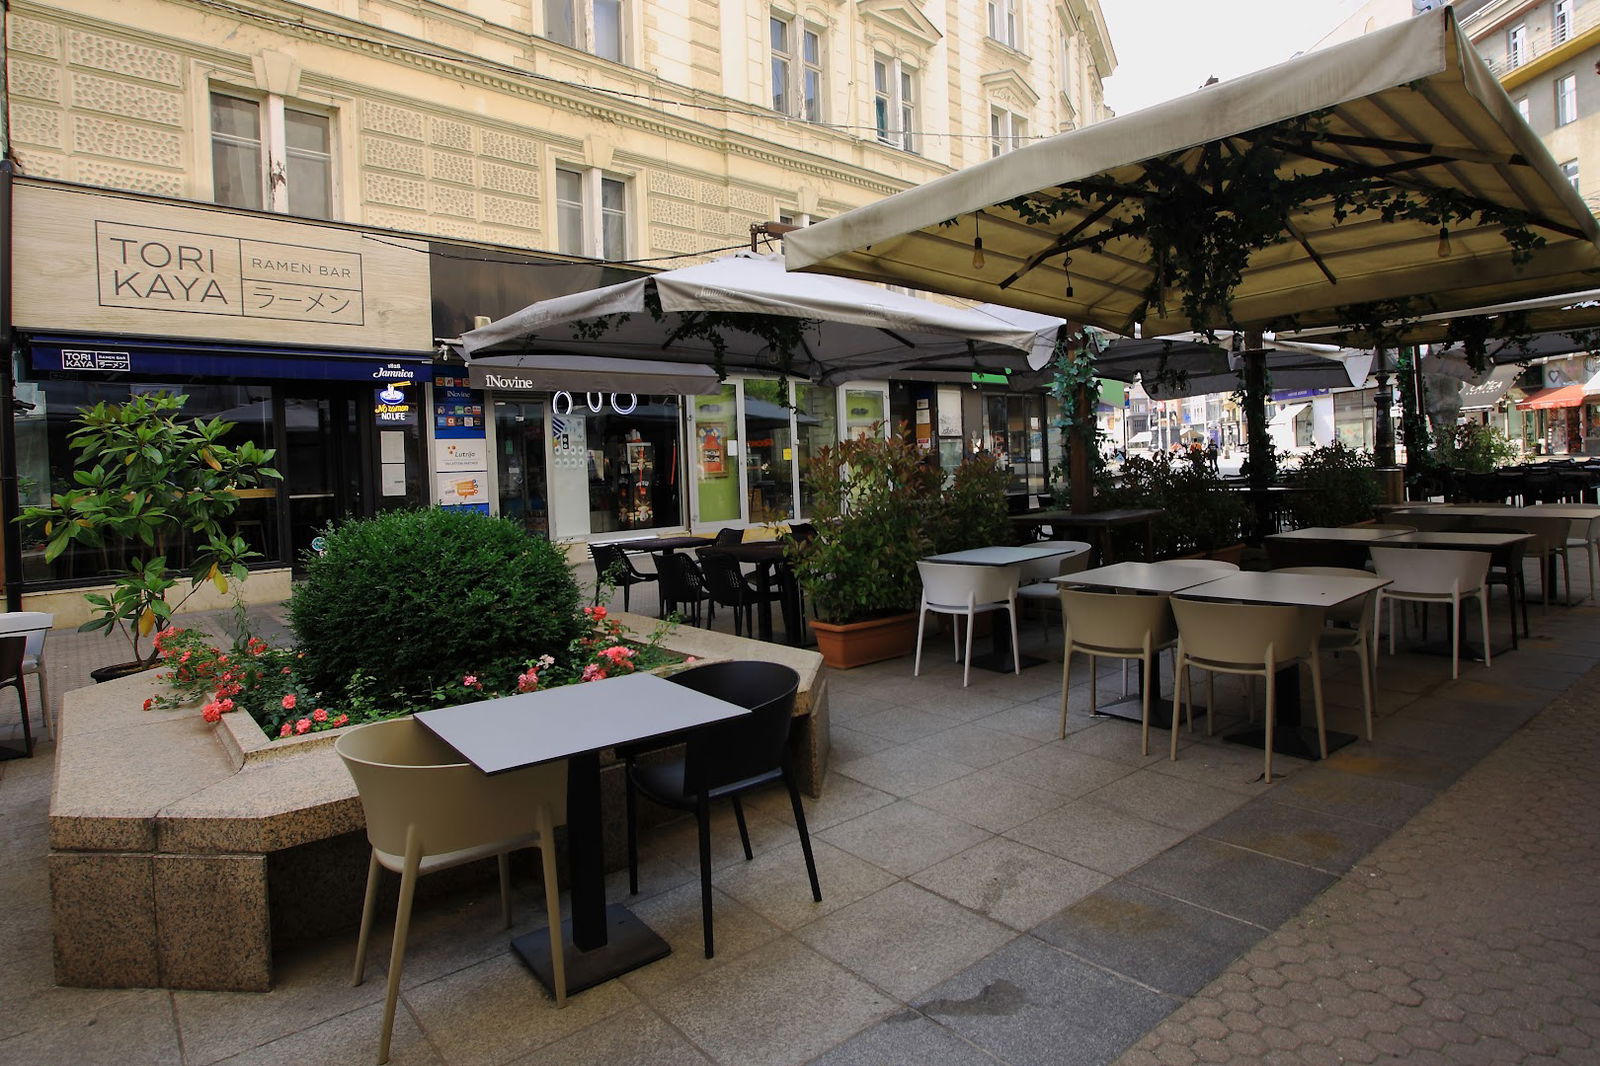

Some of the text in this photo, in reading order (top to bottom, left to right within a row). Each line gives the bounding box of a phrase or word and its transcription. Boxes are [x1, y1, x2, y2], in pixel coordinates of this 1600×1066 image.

[110, 237, 215, 274] TORI
[252, 258, 351, 279] RAMEN BAR
[114, 269, 228, 305] KAYA
[253, 286, 350, 314] ラーメン
[65, 353, 91, 361] TORI
[66, 360, 94, 368] KAYA
[373, 367, 414, 378] Jamnica
[381, 412, 406, 421] NO LIFE
